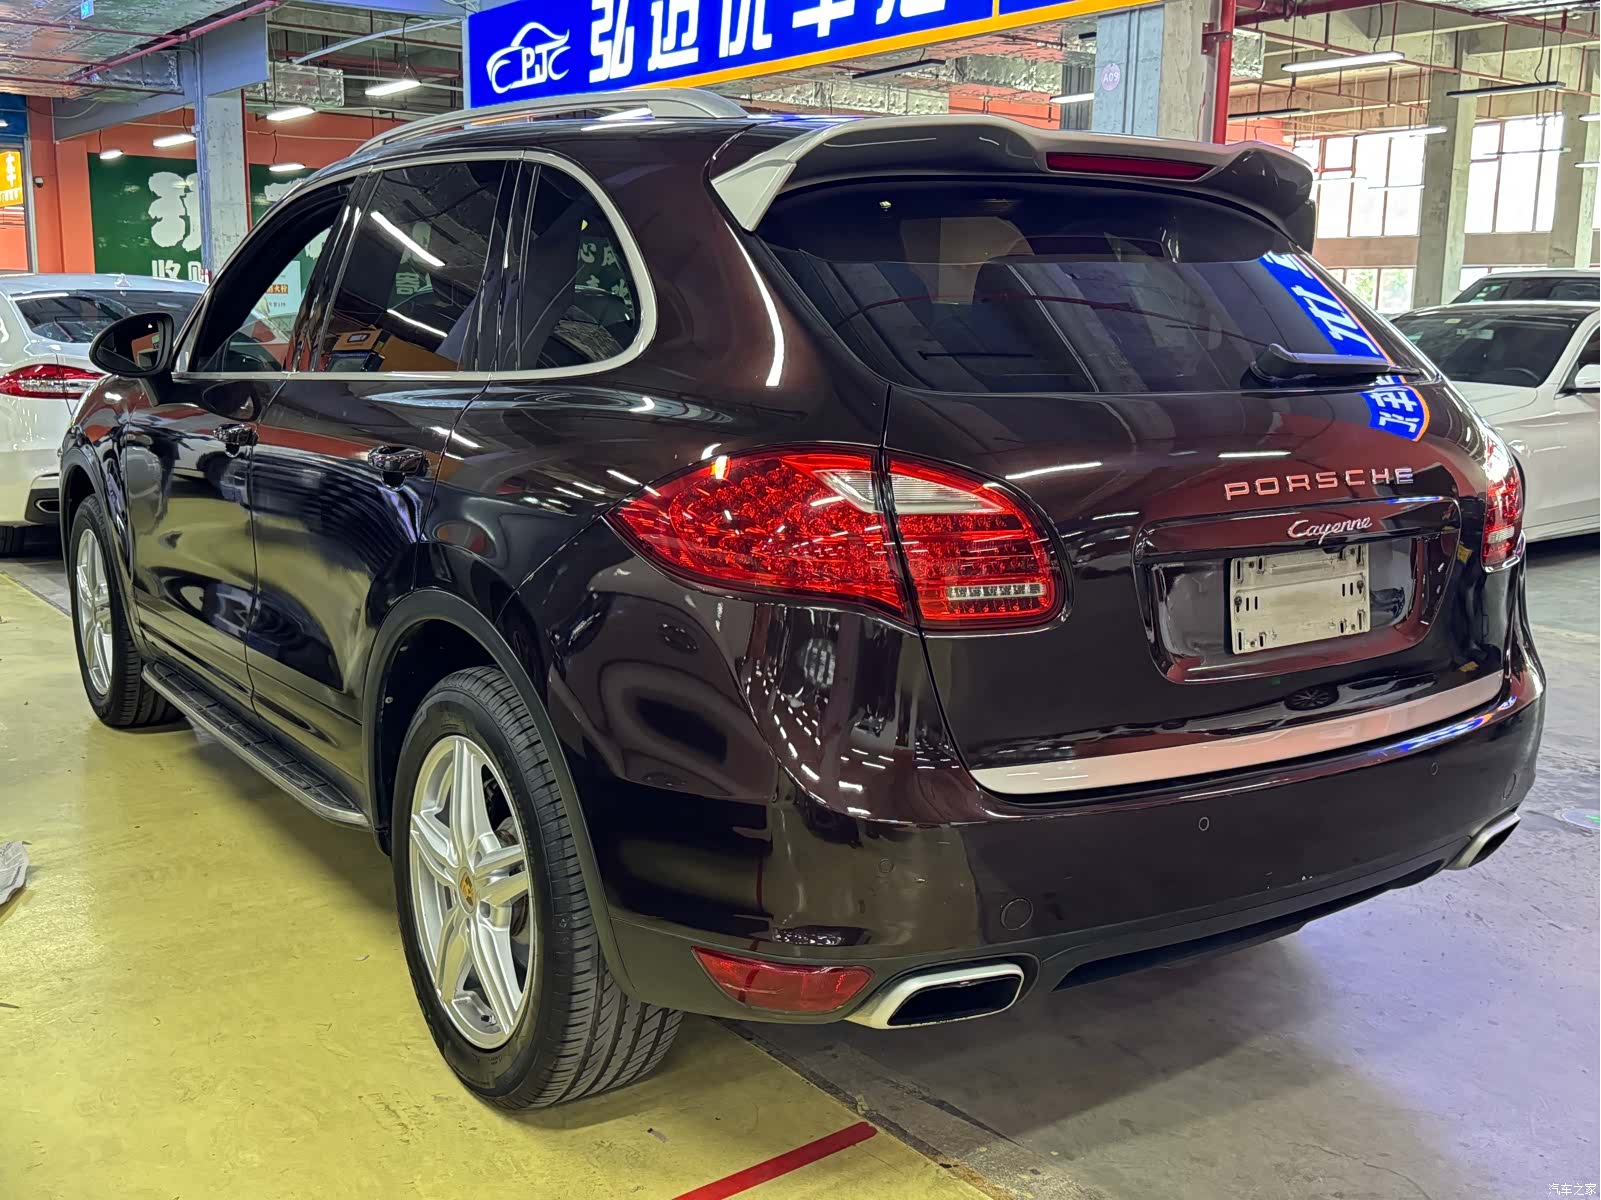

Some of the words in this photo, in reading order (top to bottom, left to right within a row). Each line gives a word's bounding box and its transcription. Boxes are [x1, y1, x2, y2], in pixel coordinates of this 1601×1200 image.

[589, 0, 945, 84] 弘迈优
[1223, 467, 1415, 501] PORSCHE
[1287, 516, 1373, 544] Cayenne
